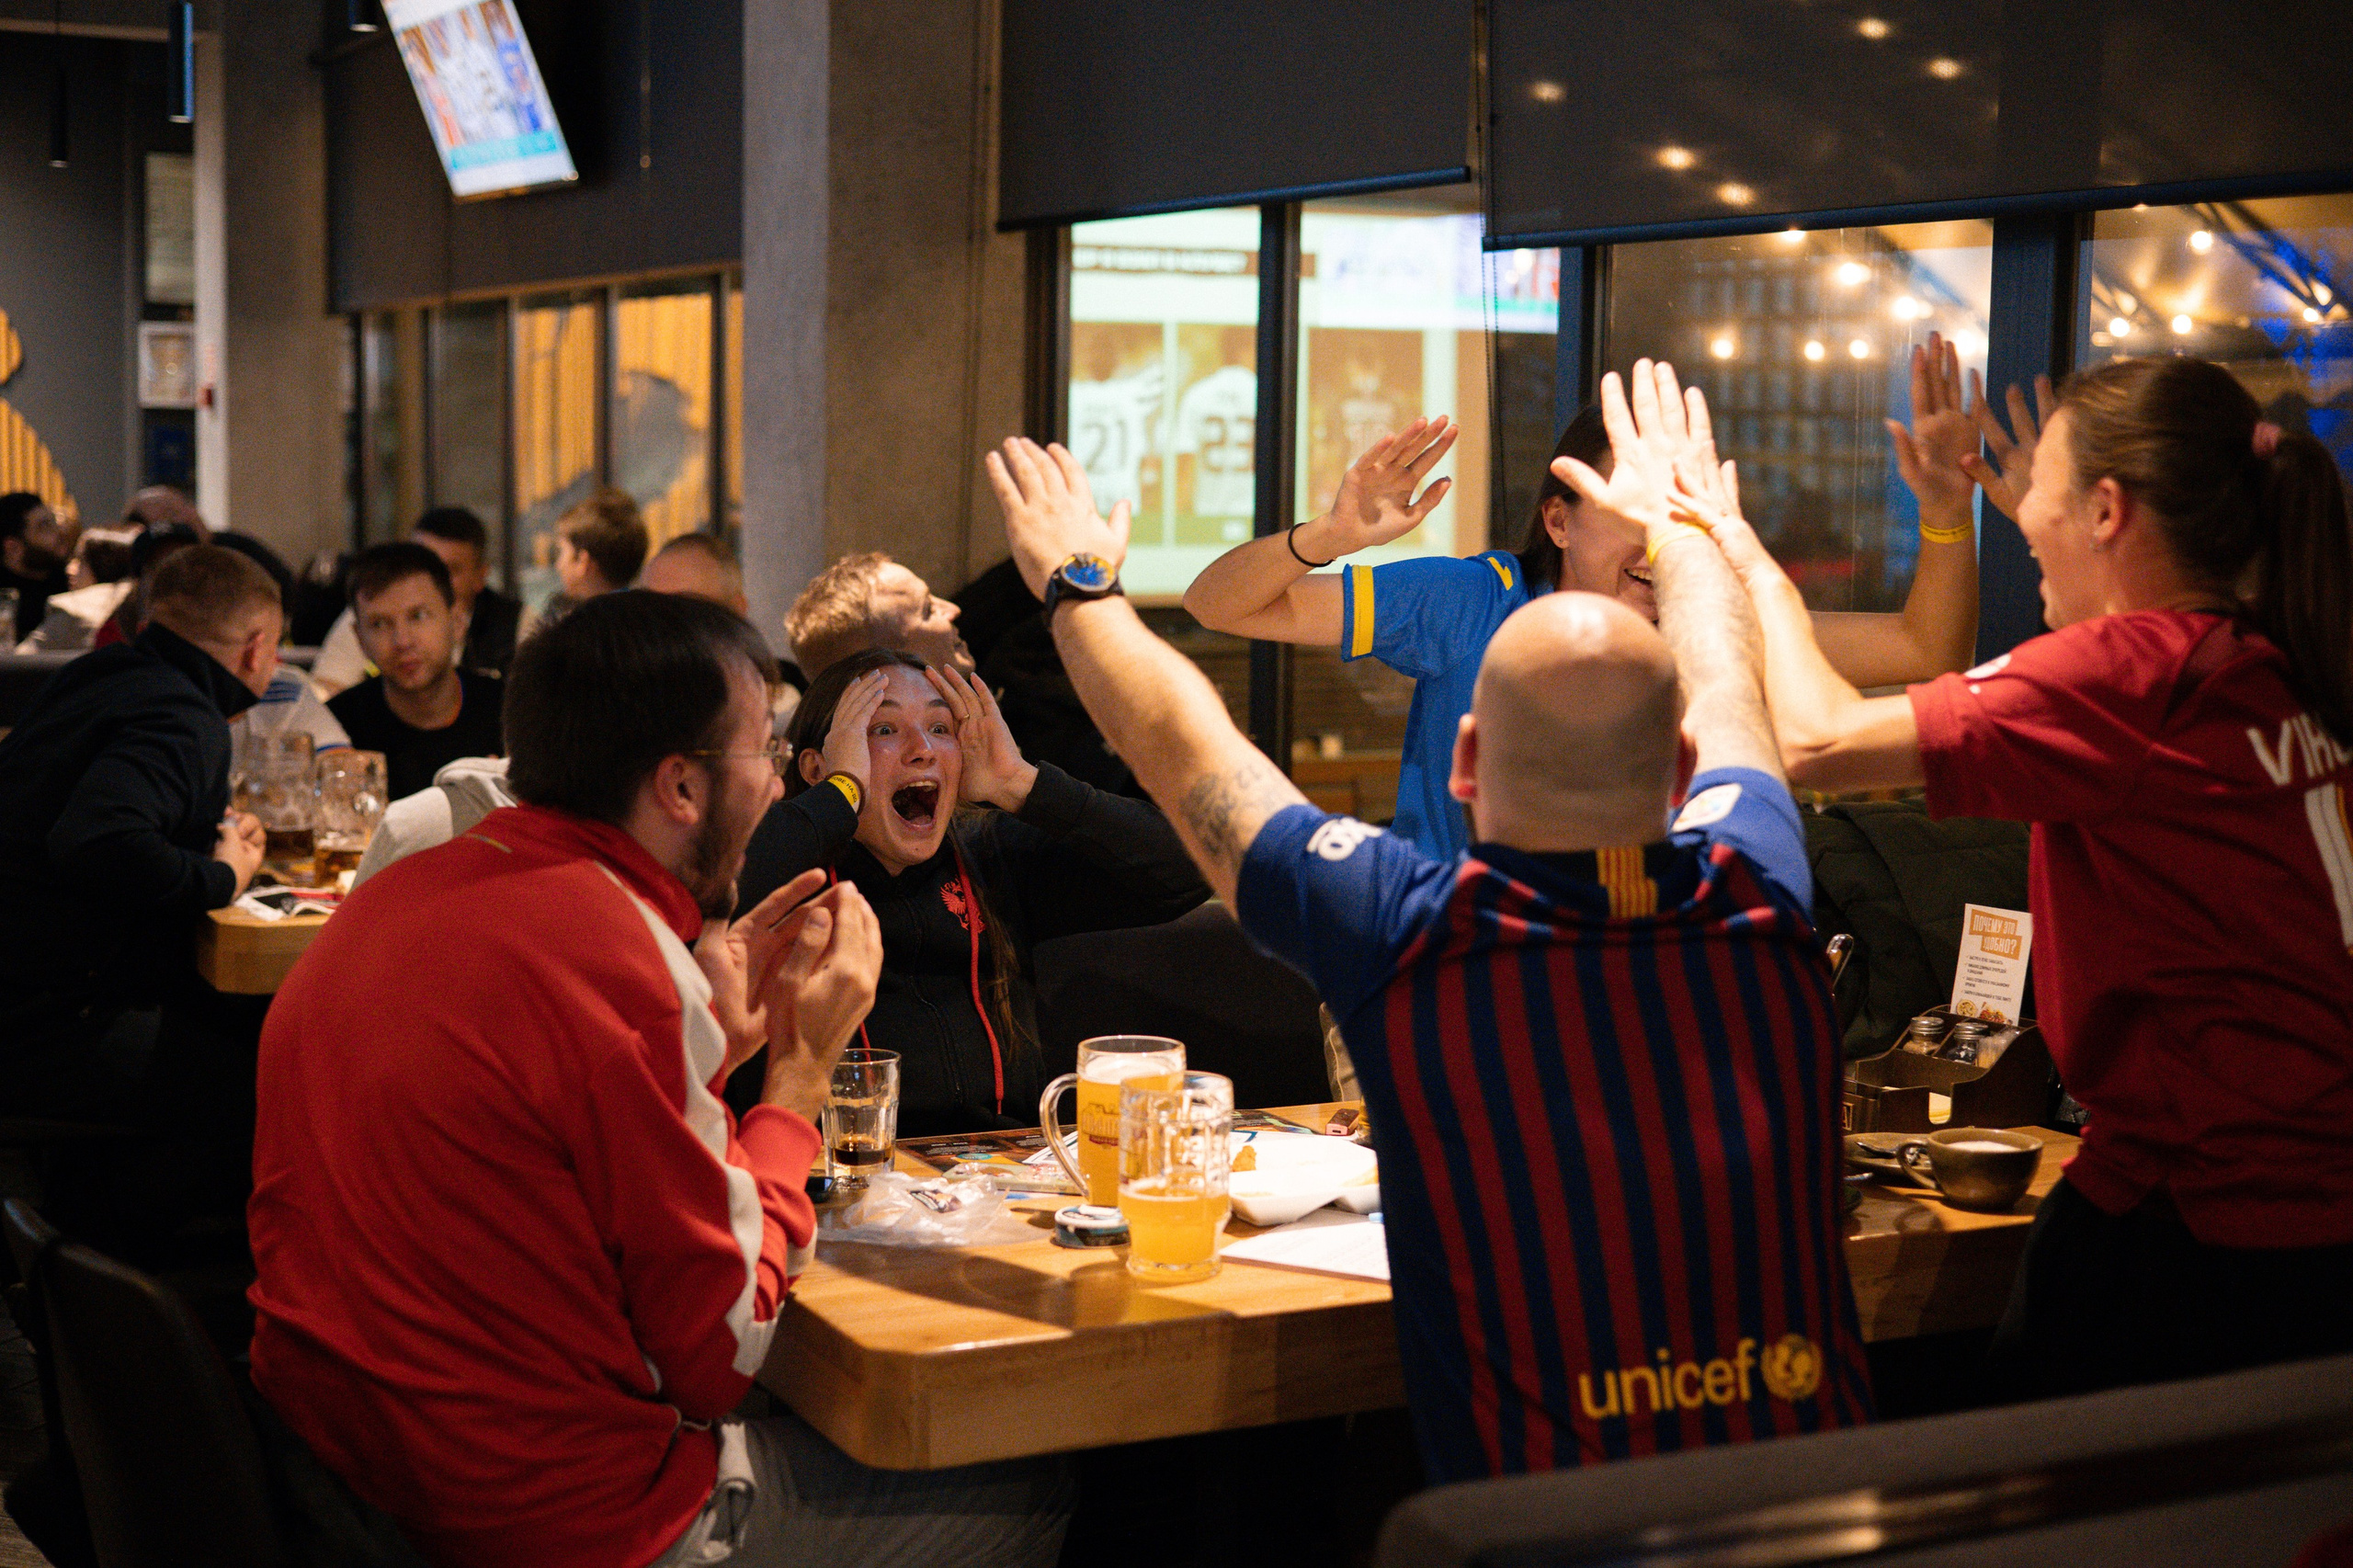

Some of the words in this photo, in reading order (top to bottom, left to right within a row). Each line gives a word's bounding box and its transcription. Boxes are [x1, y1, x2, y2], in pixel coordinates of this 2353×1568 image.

[1079, 418, 1129, 473] 21
[1201, 415, 1256, 472] 23
[1972, 914, 2004, 934] ПОЧЕМУ
[2003, 920, 2016, 936] ЭТО
[1983, 936, 2018, 955] УДОБНО?
[1577, 1336, 1757, 1420] unicef
